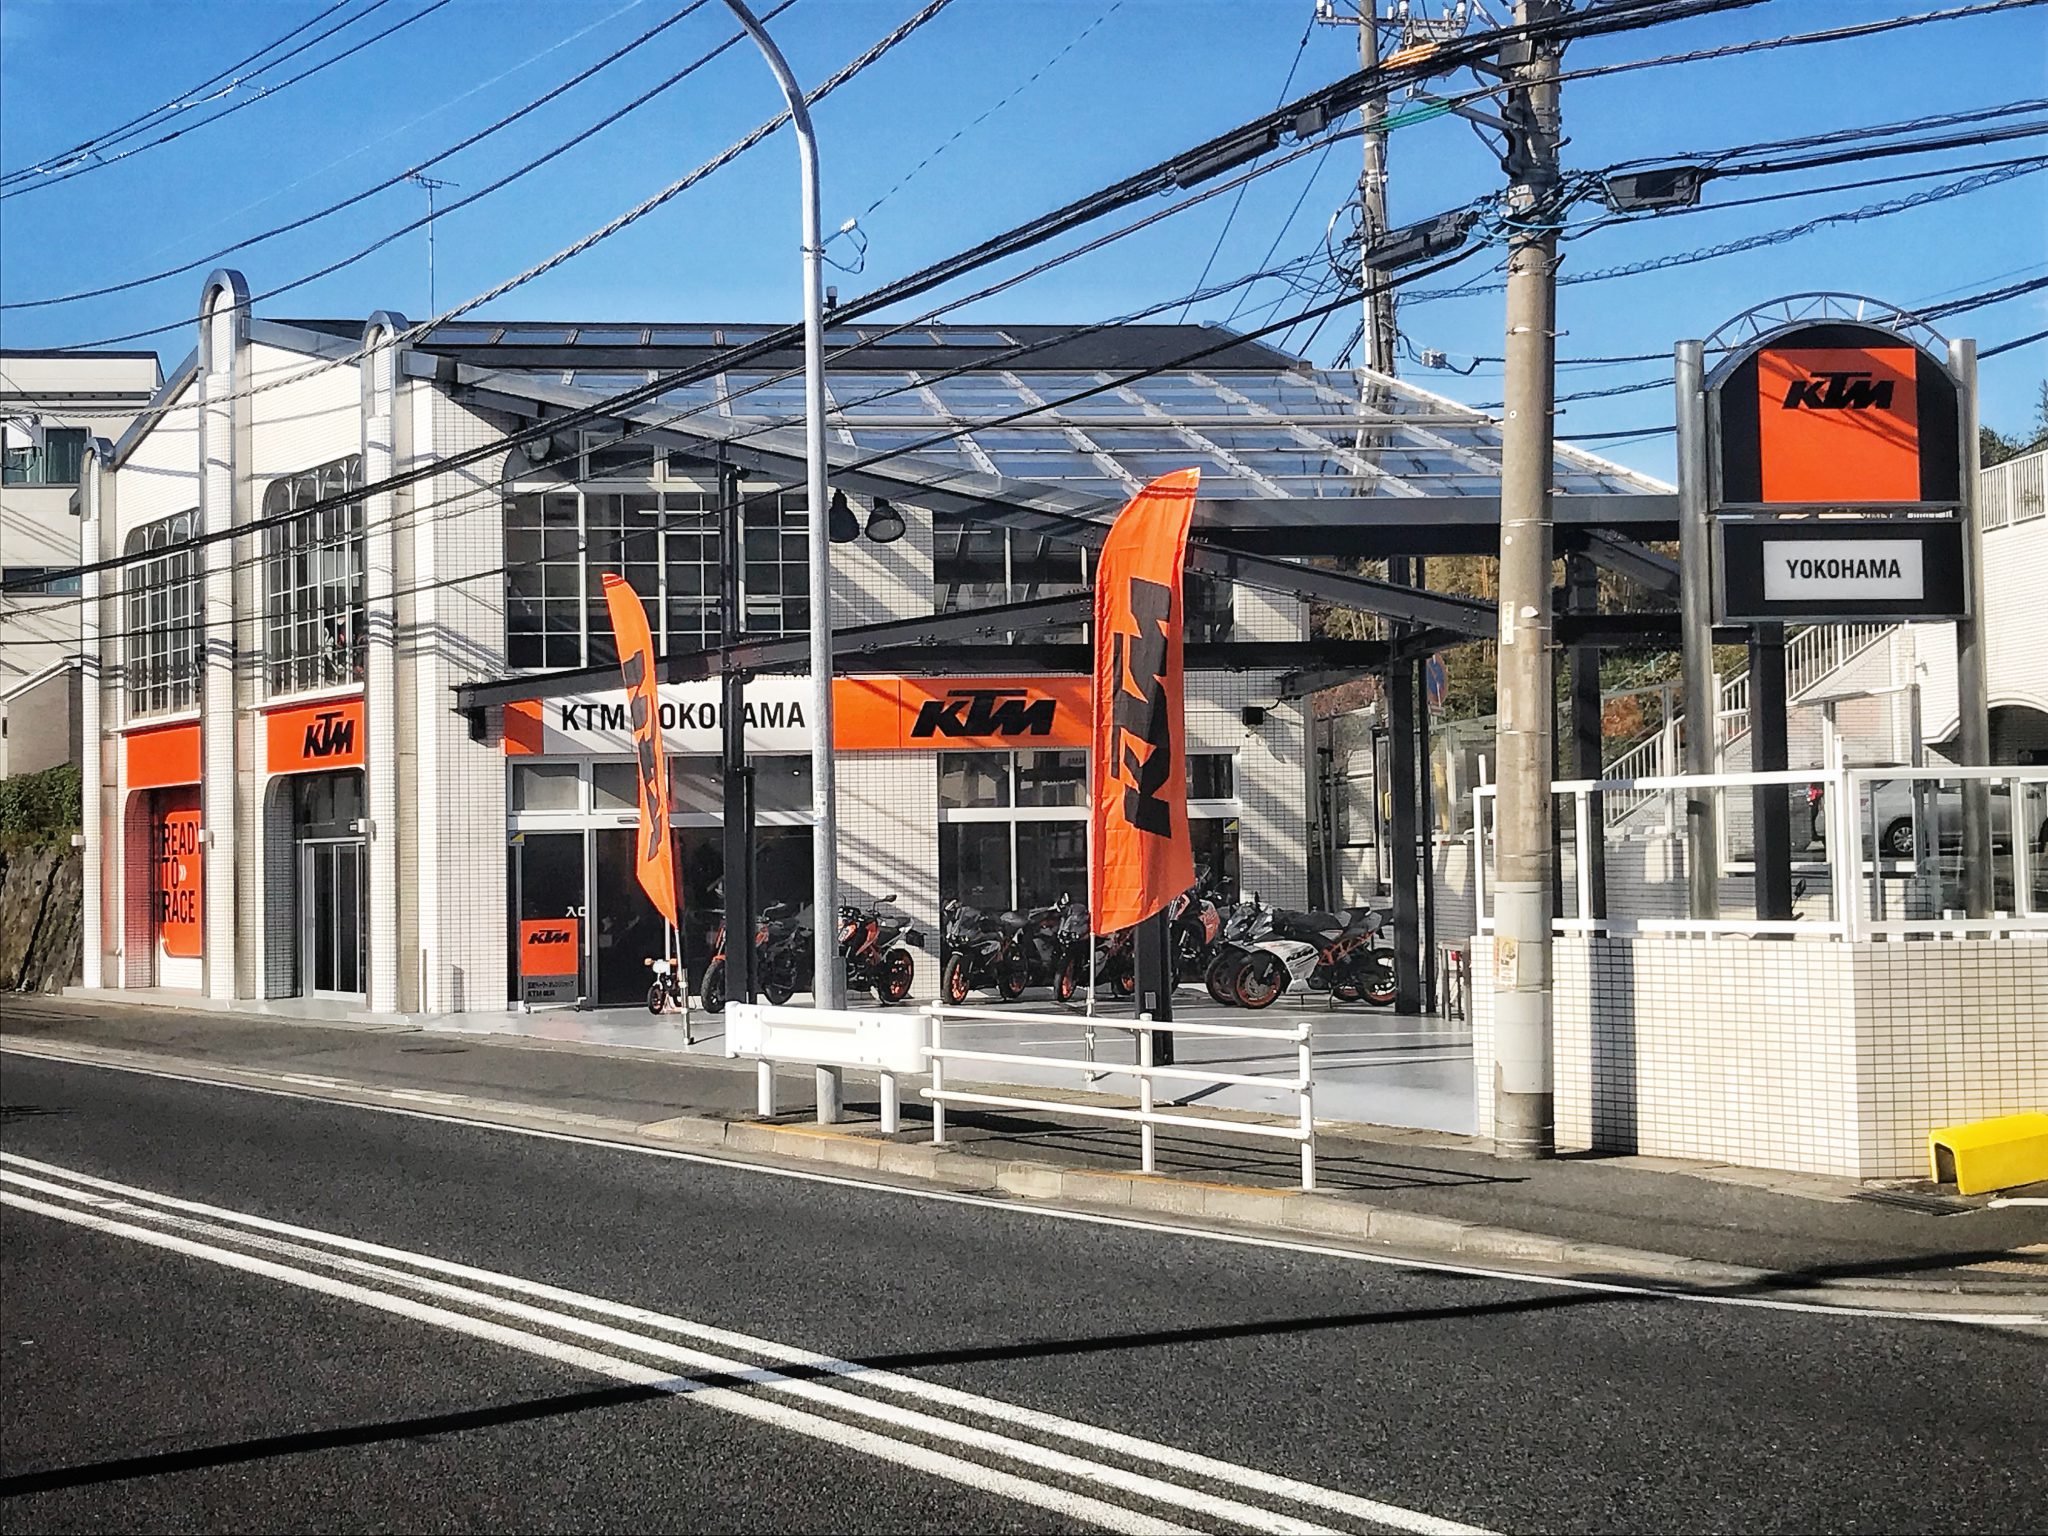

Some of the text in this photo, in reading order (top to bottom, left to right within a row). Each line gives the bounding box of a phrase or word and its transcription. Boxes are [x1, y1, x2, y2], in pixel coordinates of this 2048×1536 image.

[1782, 371, 1894, 410] KTM
[1786, 558, 1901, 580] YOKOHAMA
[561, 702, 805, 731] KTM OKOAMA
[911, 689, 1056, 737] KTM
[303, 711, 355, 758] KTM
[162, 857, 180, 889] TO
[163, 890, 195, 923] RACE
[528, 929, 570, 944] KTM
